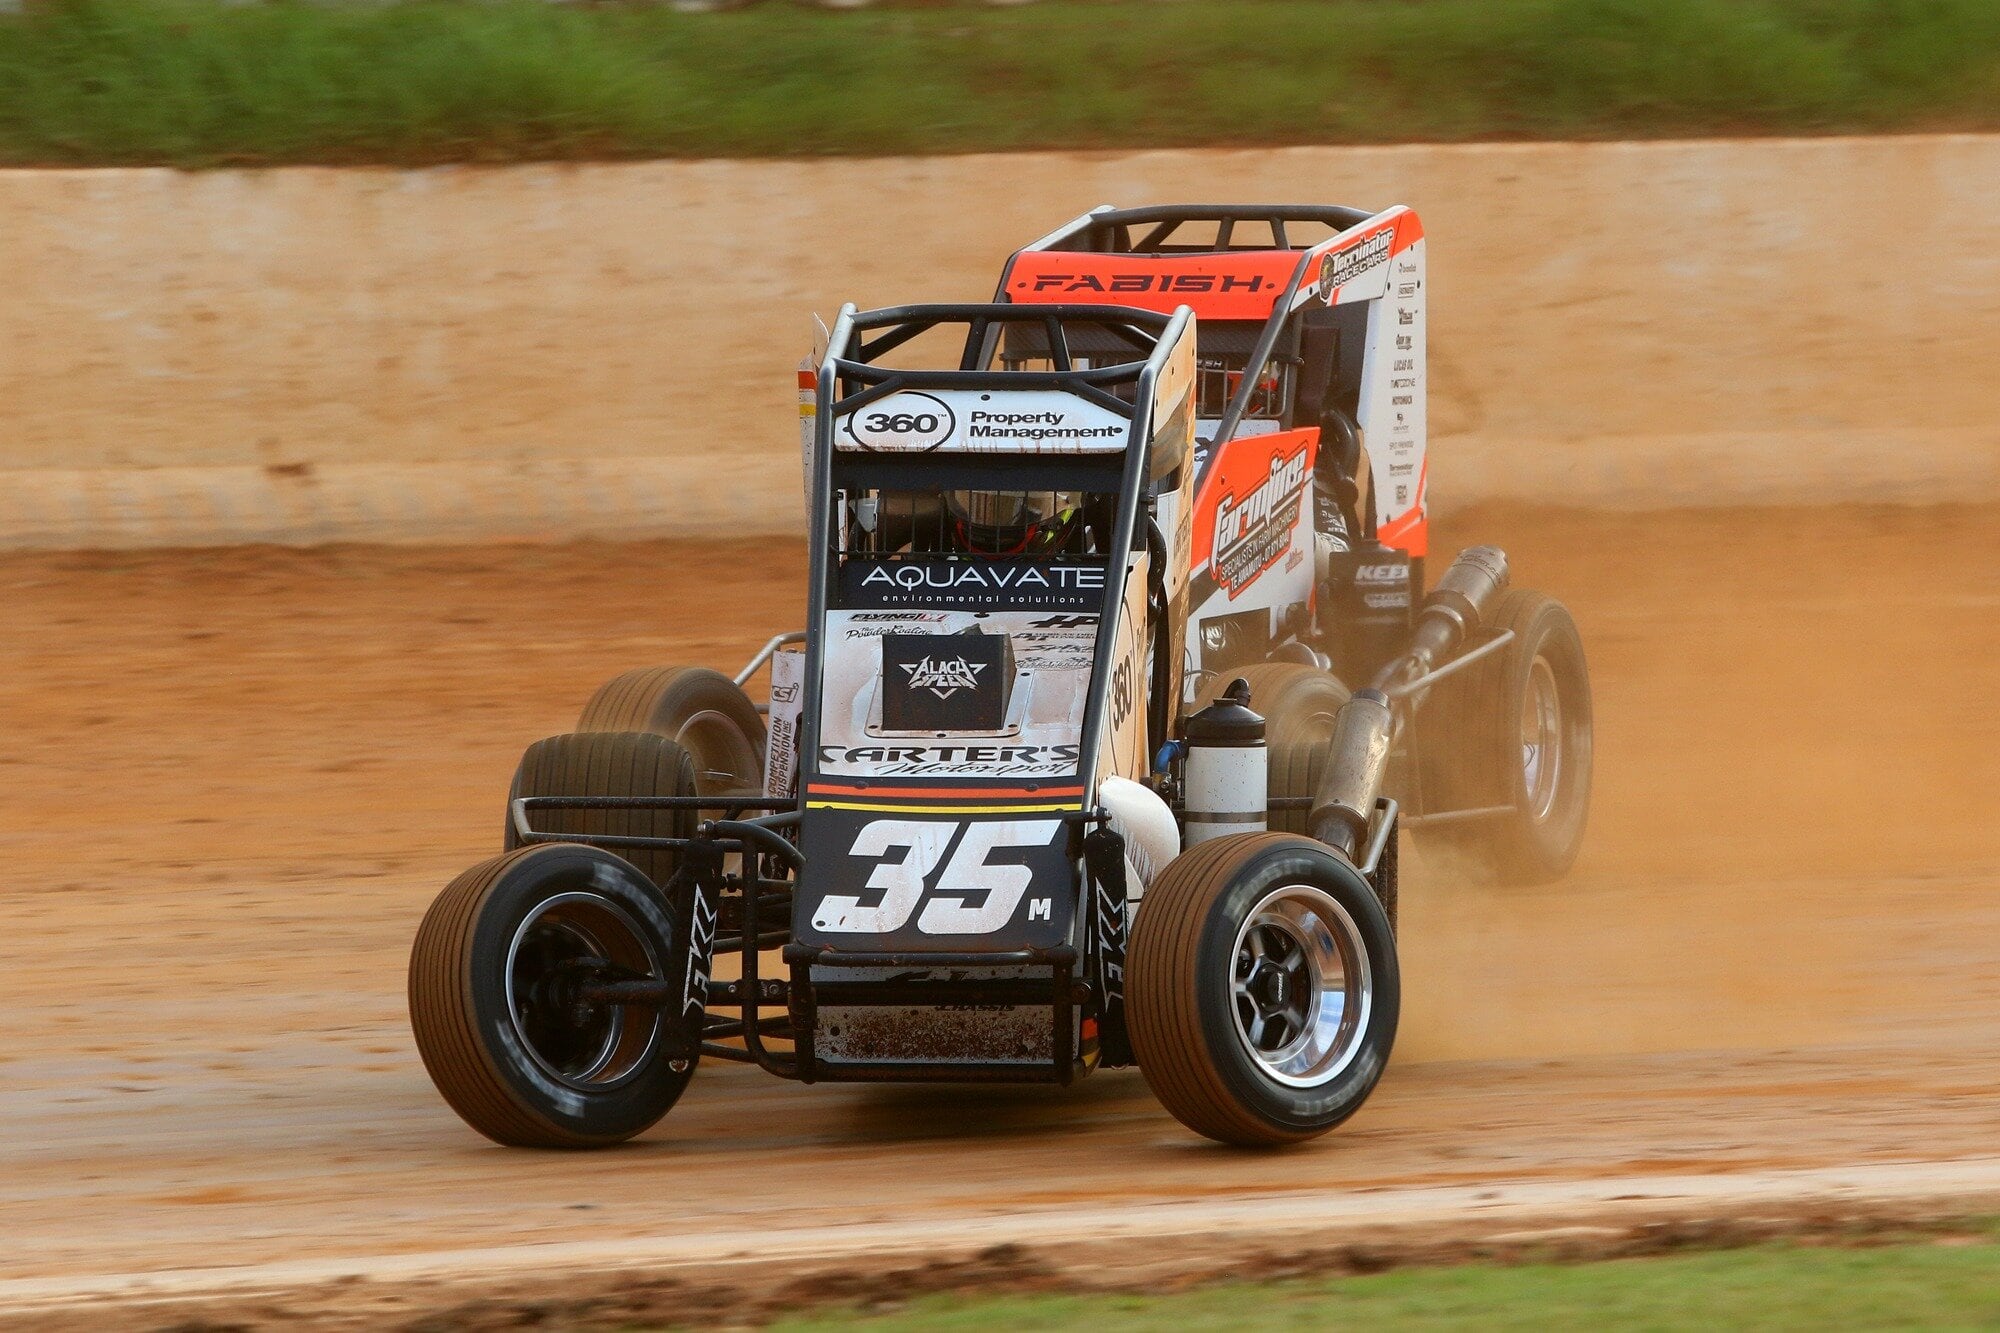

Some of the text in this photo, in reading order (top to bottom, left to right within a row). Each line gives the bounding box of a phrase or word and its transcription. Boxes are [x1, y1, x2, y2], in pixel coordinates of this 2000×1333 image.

[1332, 229, 1393, 274] Terminator
[1032, 274, 1262, 293] FABISH
[864, 413, 938, 433] 360
[970, 411, 1065, 426] Property
[969, 426, 1115, 439] Management
[861, 566, 1105, 591] AQUAVATE
[1010, 595, 1084, 603] solutions
[1112, 654, 1132, 732] 360
[768, 716, 783, 794] COMPETITION
[819, 744, 1080, 763] CARTER'S
[778, 733, 791, 799] SUSPENSION
[874, 761, 1077, 776] Motorsport
[811, 819, 1062, 934] 35 M
